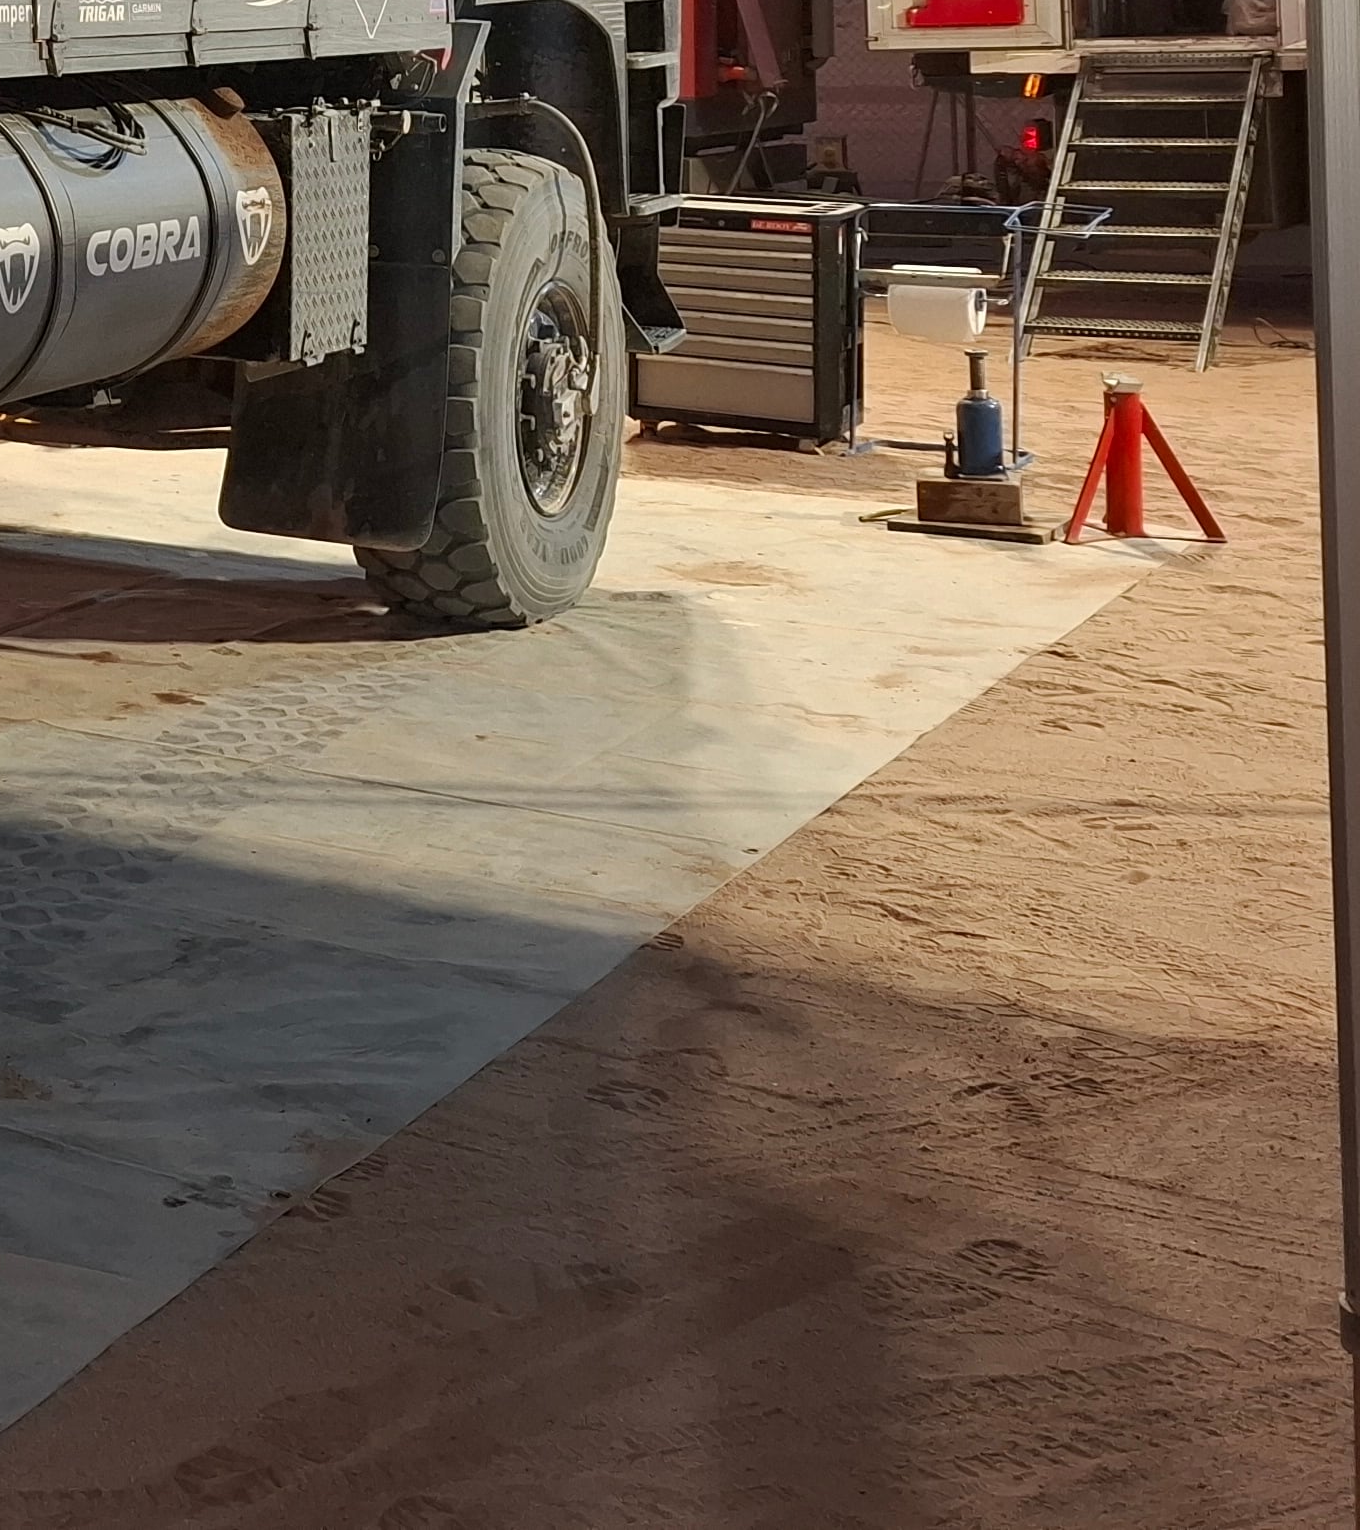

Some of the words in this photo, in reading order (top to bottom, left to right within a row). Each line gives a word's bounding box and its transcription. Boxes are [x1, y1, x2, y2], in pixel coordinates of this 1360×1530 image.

[79, 4, 125, 23] TRIGAR
[132, 2, 162, 14] GARMIN
[86, 215, 201, 277] COBRA
